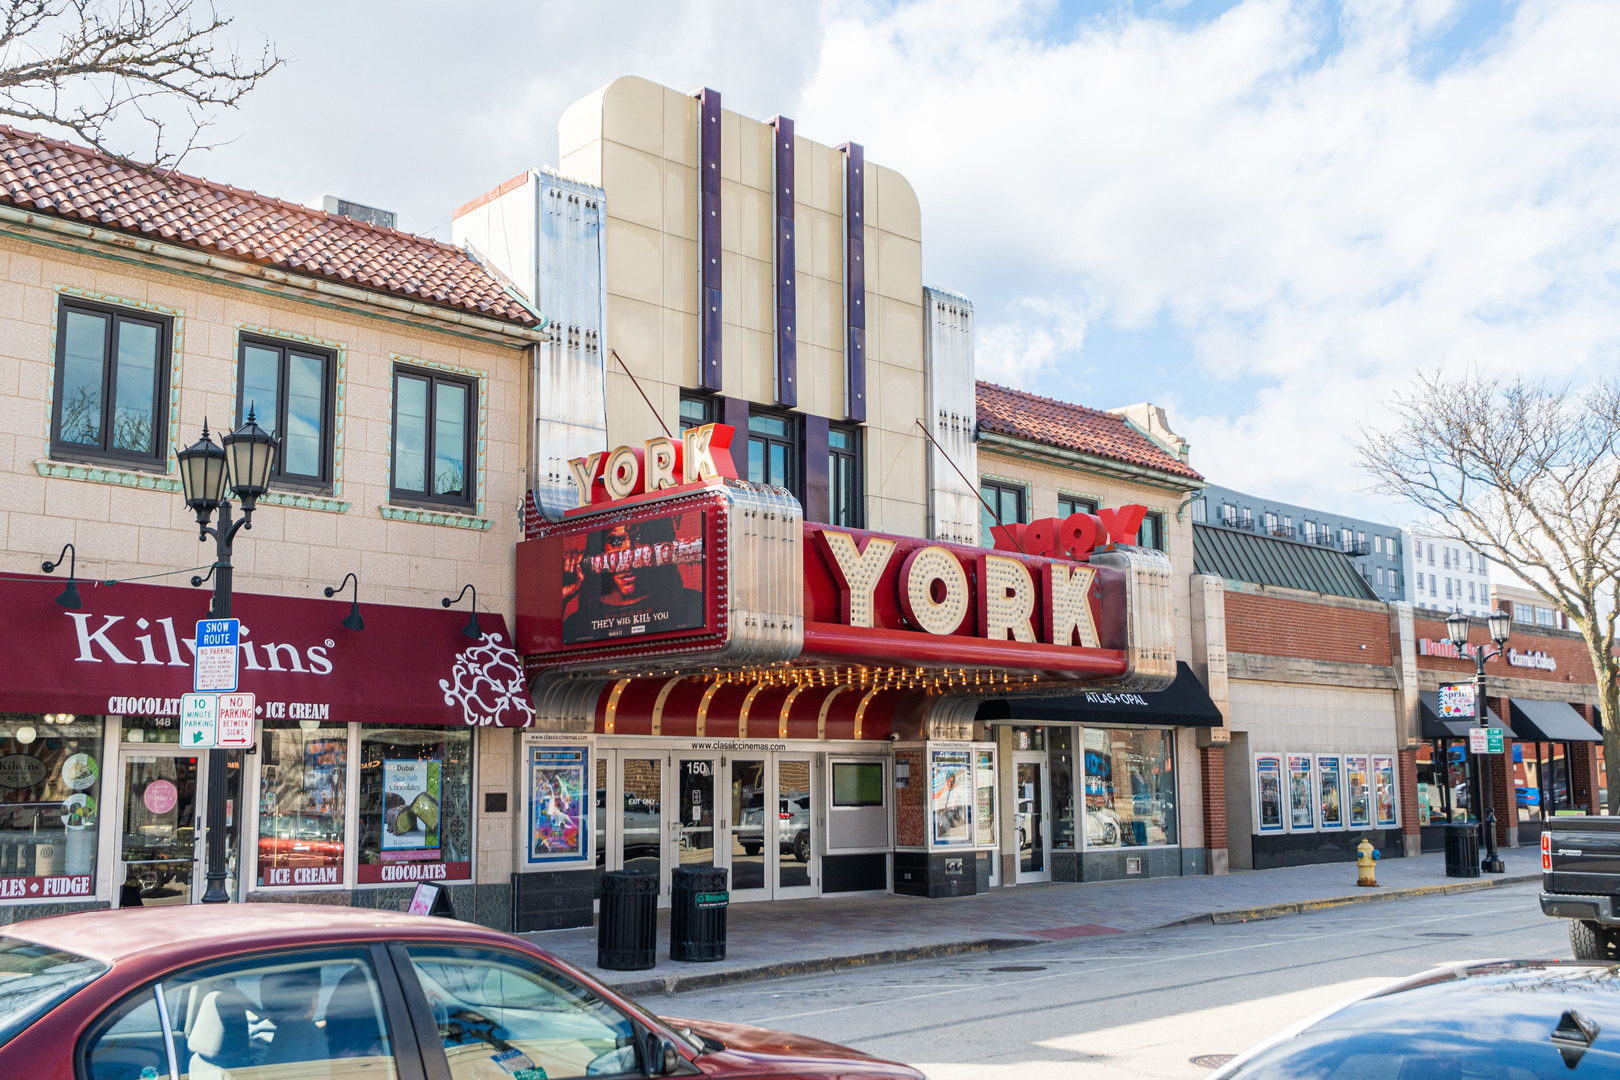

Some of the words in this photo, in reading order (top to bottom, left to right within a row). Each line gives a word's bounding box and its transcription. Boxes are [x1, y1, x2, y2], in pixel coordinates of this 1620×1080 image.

[567, 423, 722, 507] YORK
[816, 530, 1101, 648] YORK
[591, 618, 615, 630] THEY
[617, 617, 631, 626] WILL
[633, 613, 651, 625] KILL
[653, 611, 669, 621] YOU
[206, 622, 230, 633] SNOW
[203, 633, 231, 645] ROUTE
[210, 647, 234, 655] PARKING
[1444, 690, 1472, 700] spring
[108, 696, 182, 715] CHOCOLAT
[194, 699, 206, 709] 10
[229, 697, 243, 707] NO
[220, 708, 252, 718] PARKING
[265, 702, 286, 718] ICE
[288, 702, 330, 720] CREAM
[154, 718, 172, 726] 148
[184, 720, 214, 728] PARKING
[691, 741, 786, 751] www.classiccinemas.com
[396, 764, 415, 772] Dubai
[687, 762, 706, 774] 150
[270, 868, 290, 884] ICE
[294, 867, 337, 883] CREAM
[381, 864, 446, 881] CHOCOLATES
[0, 878, 26, 897] LES
[43, 876, 90, 896] FUDGE
